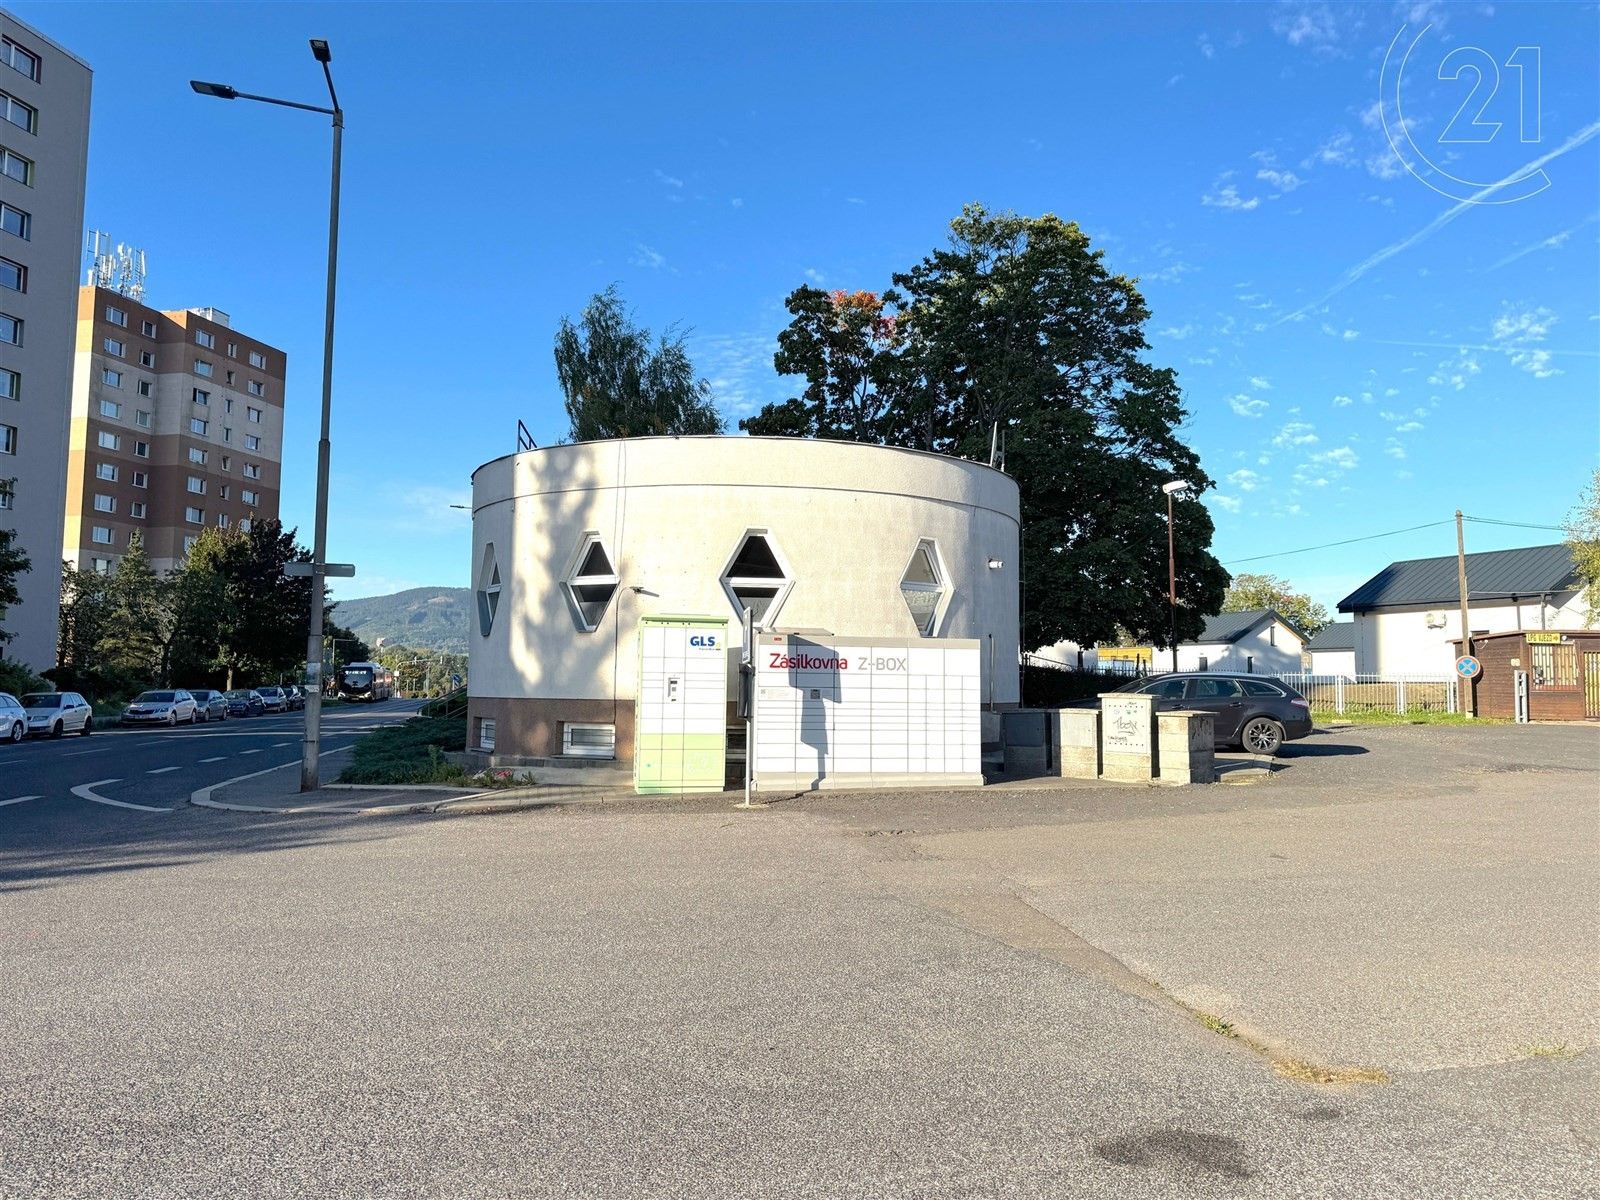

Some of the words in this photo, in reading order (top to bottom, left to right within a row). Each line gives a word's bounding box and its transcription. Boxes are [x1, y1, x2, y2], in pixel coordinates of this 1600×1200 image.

[690, 636, 715, 647] GLS
[769, 653, 848, 670] Zásilkovna
[858, 657, 906, 671] Z-BOX
